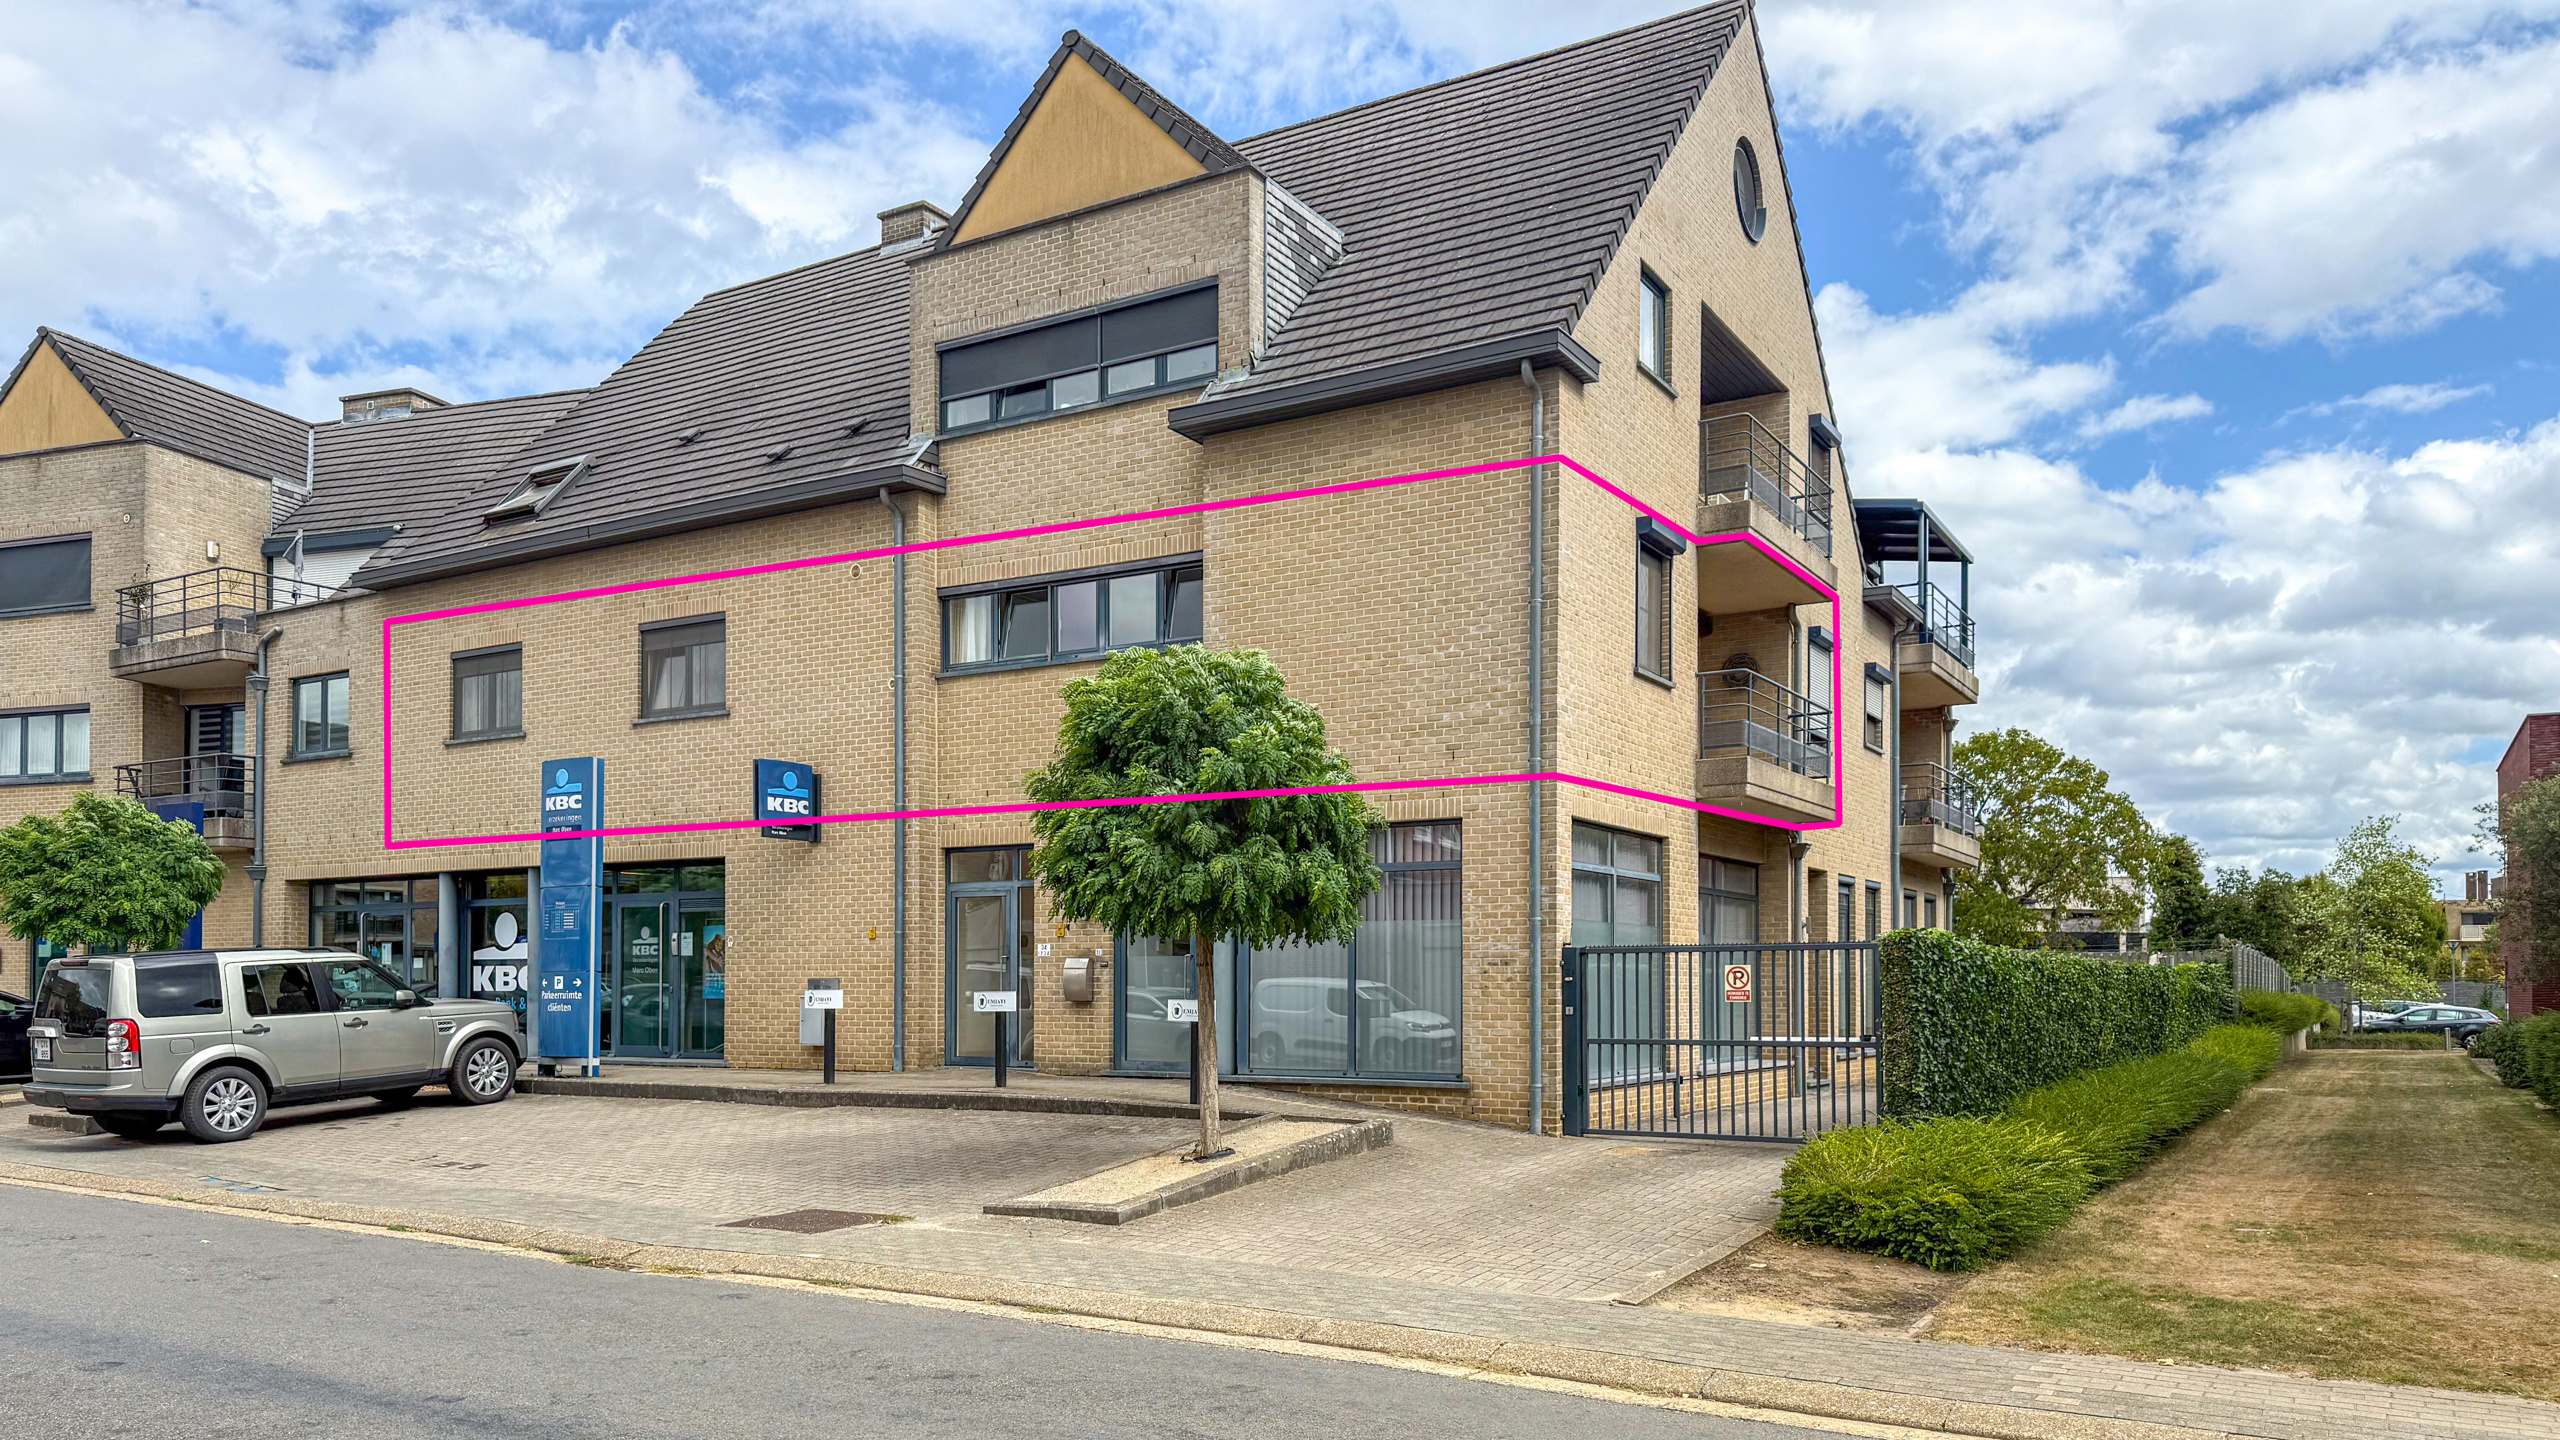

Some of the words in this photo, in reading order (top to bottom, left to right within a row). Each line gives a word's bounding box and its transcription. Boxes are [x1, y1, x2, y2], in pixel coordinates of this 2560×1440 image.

[545, 794, 582, 811] KBC
[767, 796, 809, 815] KBC
[632, 945, 658, 956] KBC
[541, 990, 582, 999] Parkeerruimte
[547, 1003, 571, 1012] cliënten
